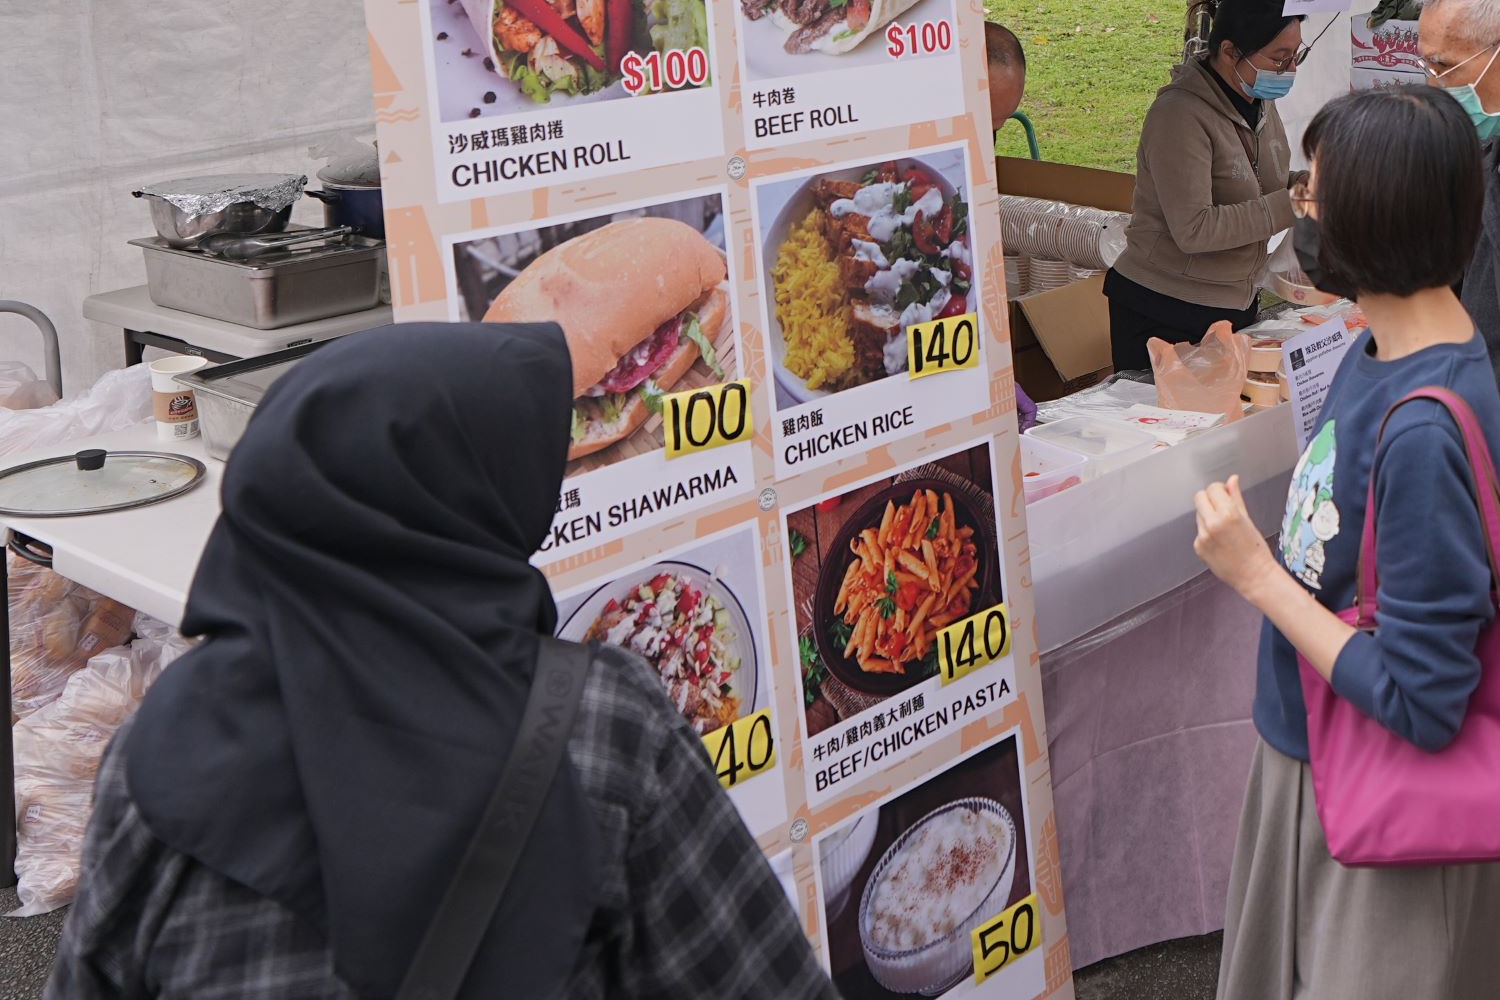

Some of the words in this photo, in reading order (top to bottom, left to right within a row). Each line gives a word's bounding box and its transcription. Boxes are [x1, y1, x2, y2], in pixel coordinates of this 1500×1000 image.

[887, 20, 952, 59] $100
[622, 48, 708, 94] $100
[751, 86, 796, 109] 牛肉卷
[447, 119, 564, 154] 沙威瑪雞肉捲
[753, 112, 805, 138] BEEF
[809, 103, 859, 127] ROLL
[451, 150, 568, 189] CHICKEN
[572, 140, 631, 174] ROLL
[912, 319, 974, 372] 140
[667, 382, 747, 453] 100
[781, 409, 824, 437] 雞肉飯
[784, 422, 868, 466] CHICKEN
[871, 406, 914, 442] RICE
[608, 466, 738, 527] SHAWARMA
[941, 611, 1007, 675] 140
[813, 694, 927, 763] 牛肉/雞肉義大利麵
[815, 706, 945, 793] BEEF/CHICKEN
[948, 679, 1011, 730] PASTA
[980, 904, 1034, 978] 50
